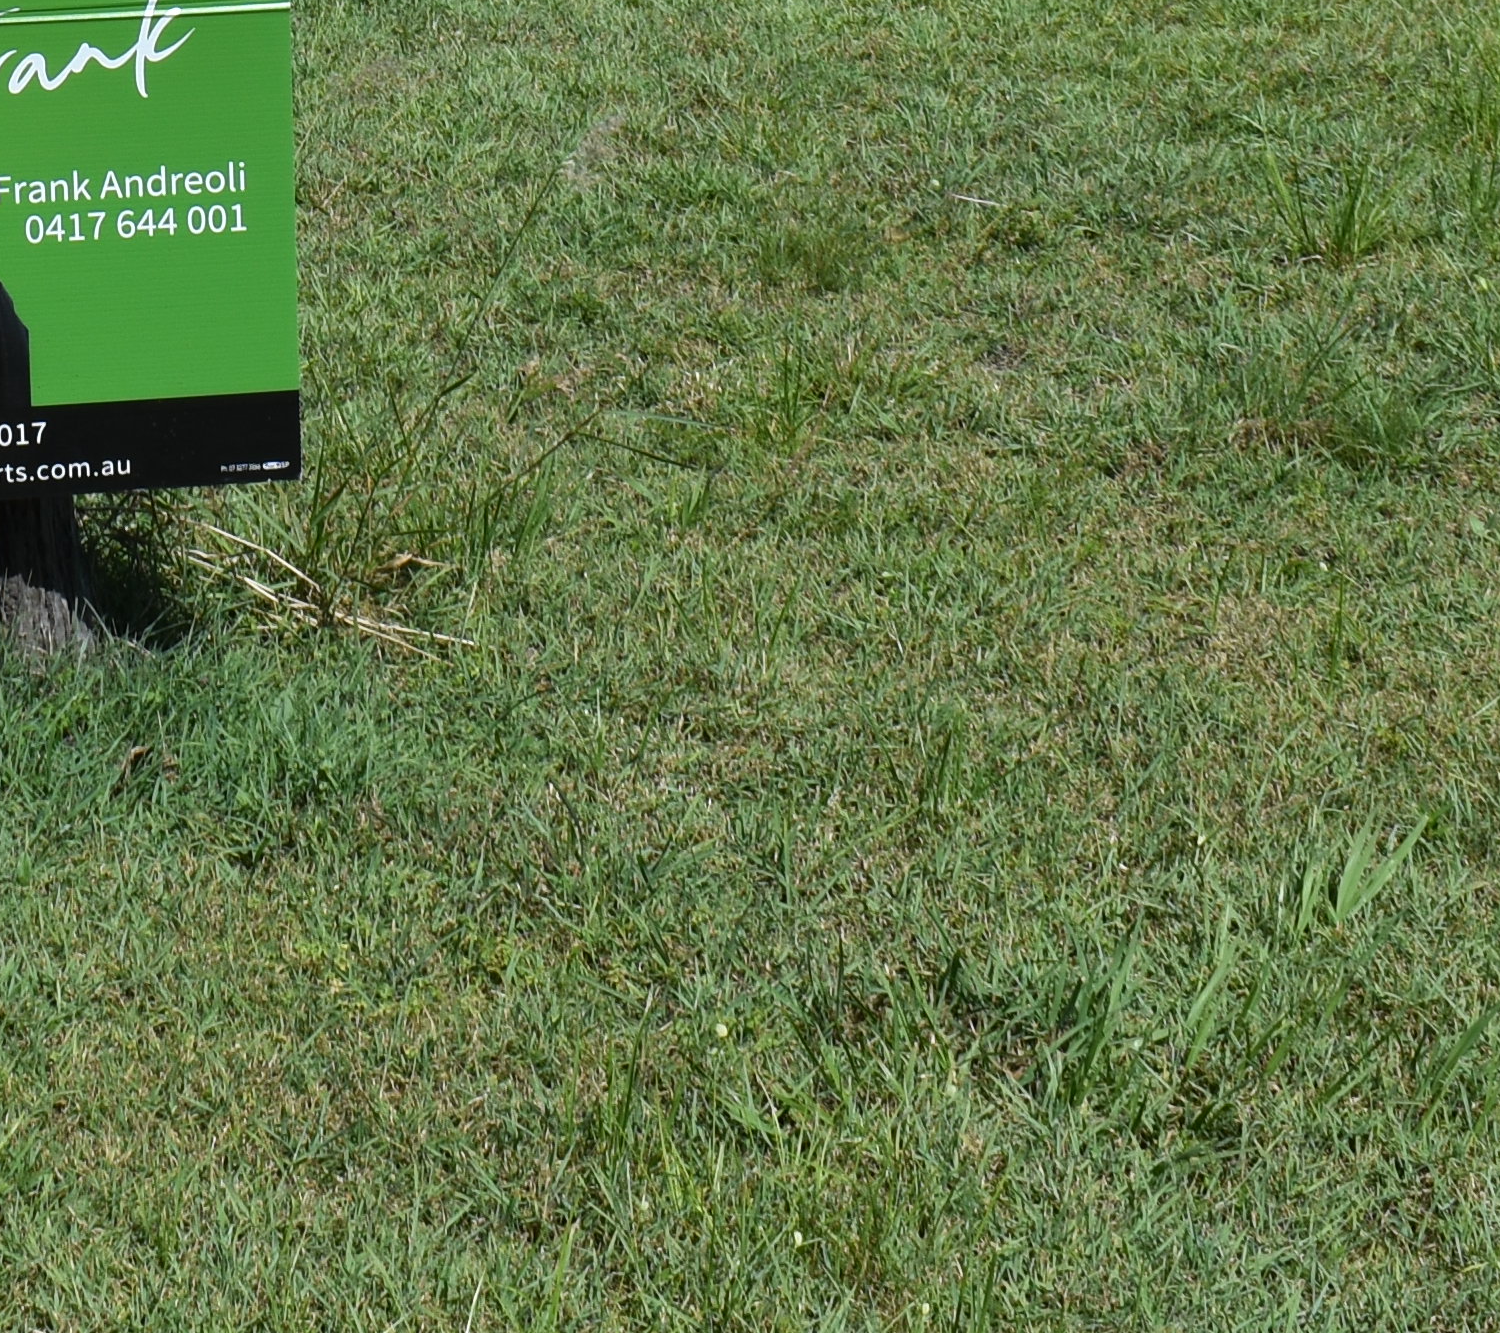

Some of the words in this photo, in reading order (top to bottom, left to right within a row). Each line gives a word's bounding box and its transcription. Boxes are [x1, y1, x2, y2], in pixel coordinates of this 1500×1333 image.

[99, 161, 247, 200] Andreoli
[24, 211, 106, 245] 0417
[116, 207, 178, 240] 644
[186, 203, 248, 235] 001
